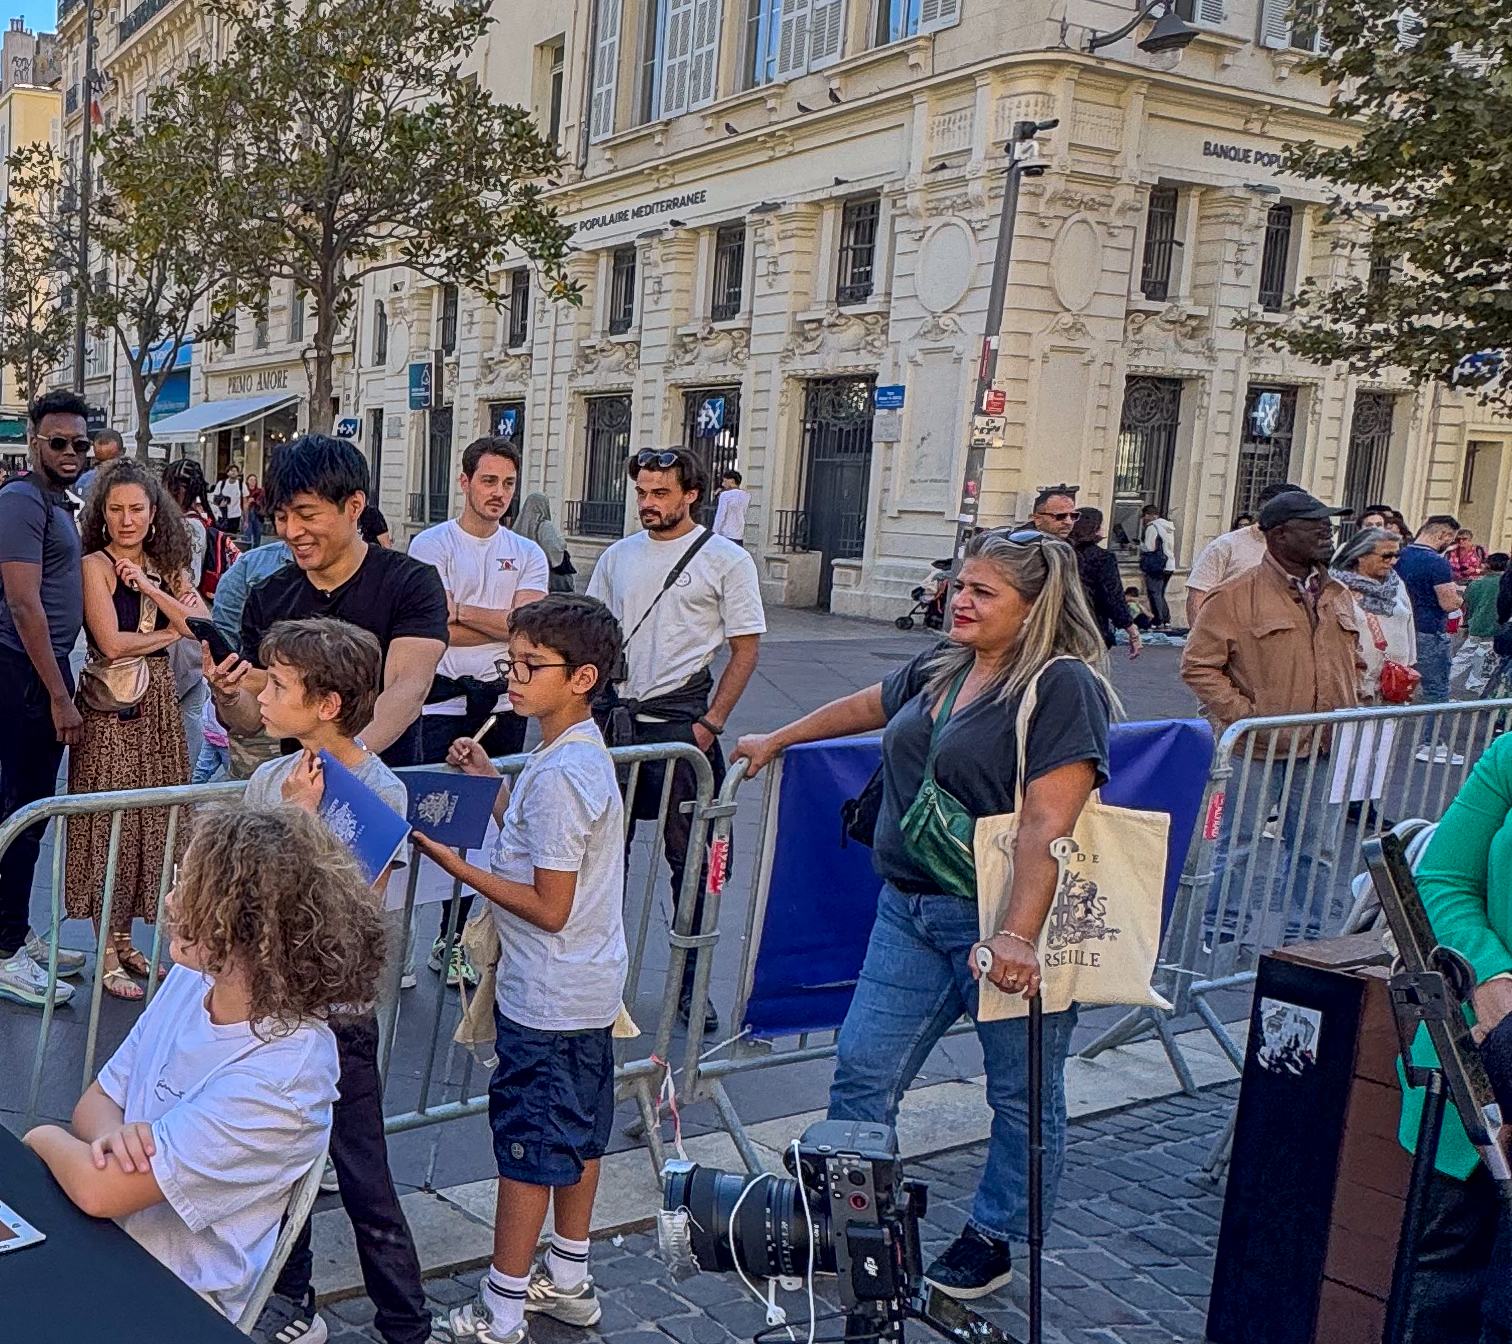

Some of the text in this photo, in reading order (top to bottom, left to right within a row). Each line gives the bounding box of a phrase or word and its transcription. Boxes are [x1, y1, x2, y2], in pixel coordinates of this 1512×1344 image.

[1202, 140, 1253, 164] BANQUE
[579, 209, 630, 232] POPULAIRE
[256, 369, 289, 392] AMORE
[1076, 853, 1101, 864] DE
[1044, 949, 1101, 968] RSEILLE
